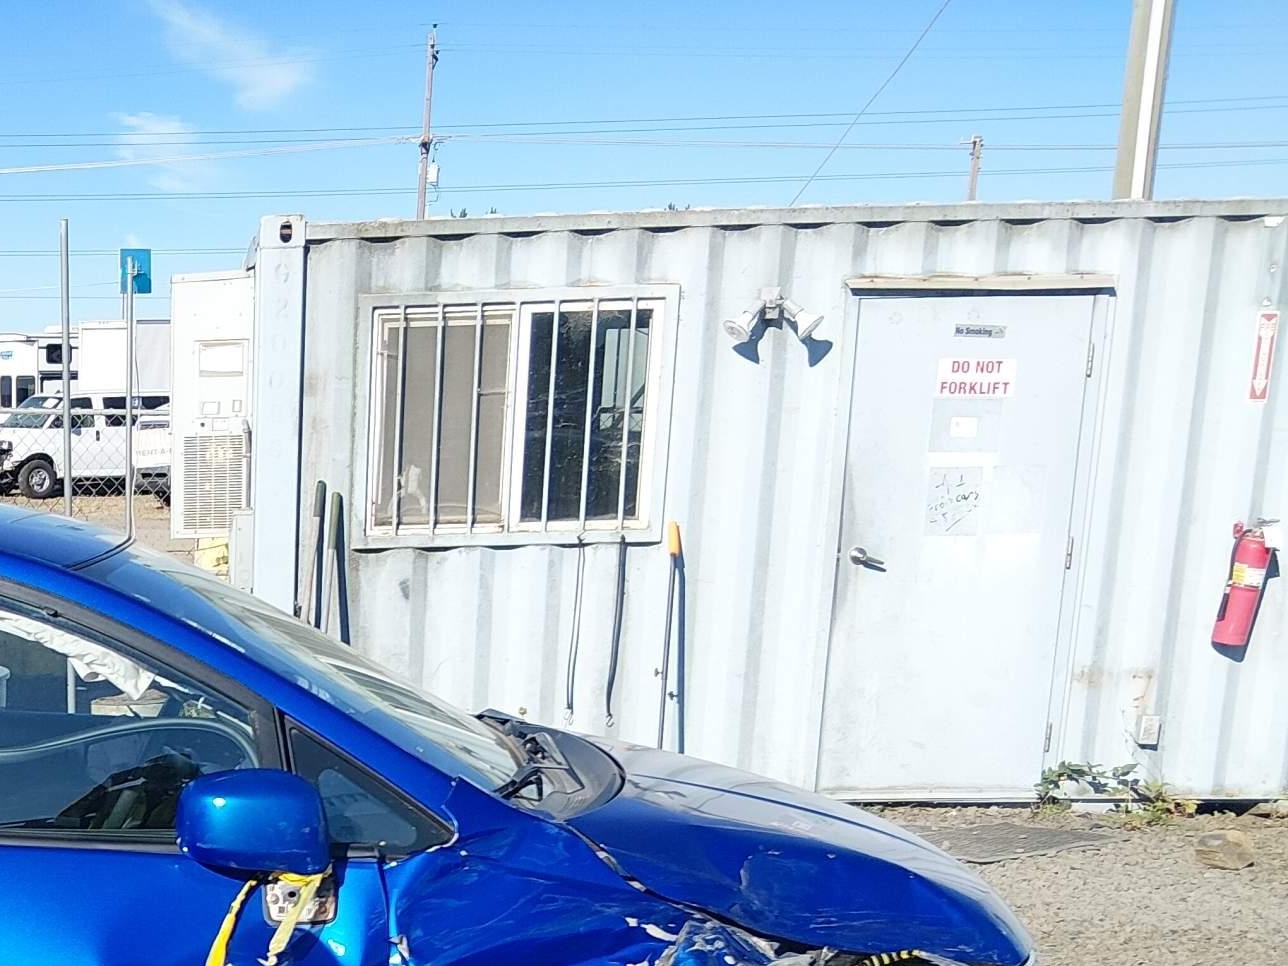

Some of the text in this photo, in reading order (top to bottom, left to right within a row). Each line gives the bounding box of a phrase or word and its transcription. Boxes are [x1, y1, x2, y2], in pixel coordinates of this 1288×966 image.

[955, 327, 993, 337] No Smoking
[951, 360, 1004, 374] DO NOT
[939, 381, 1010, 395] FORKLIFT
